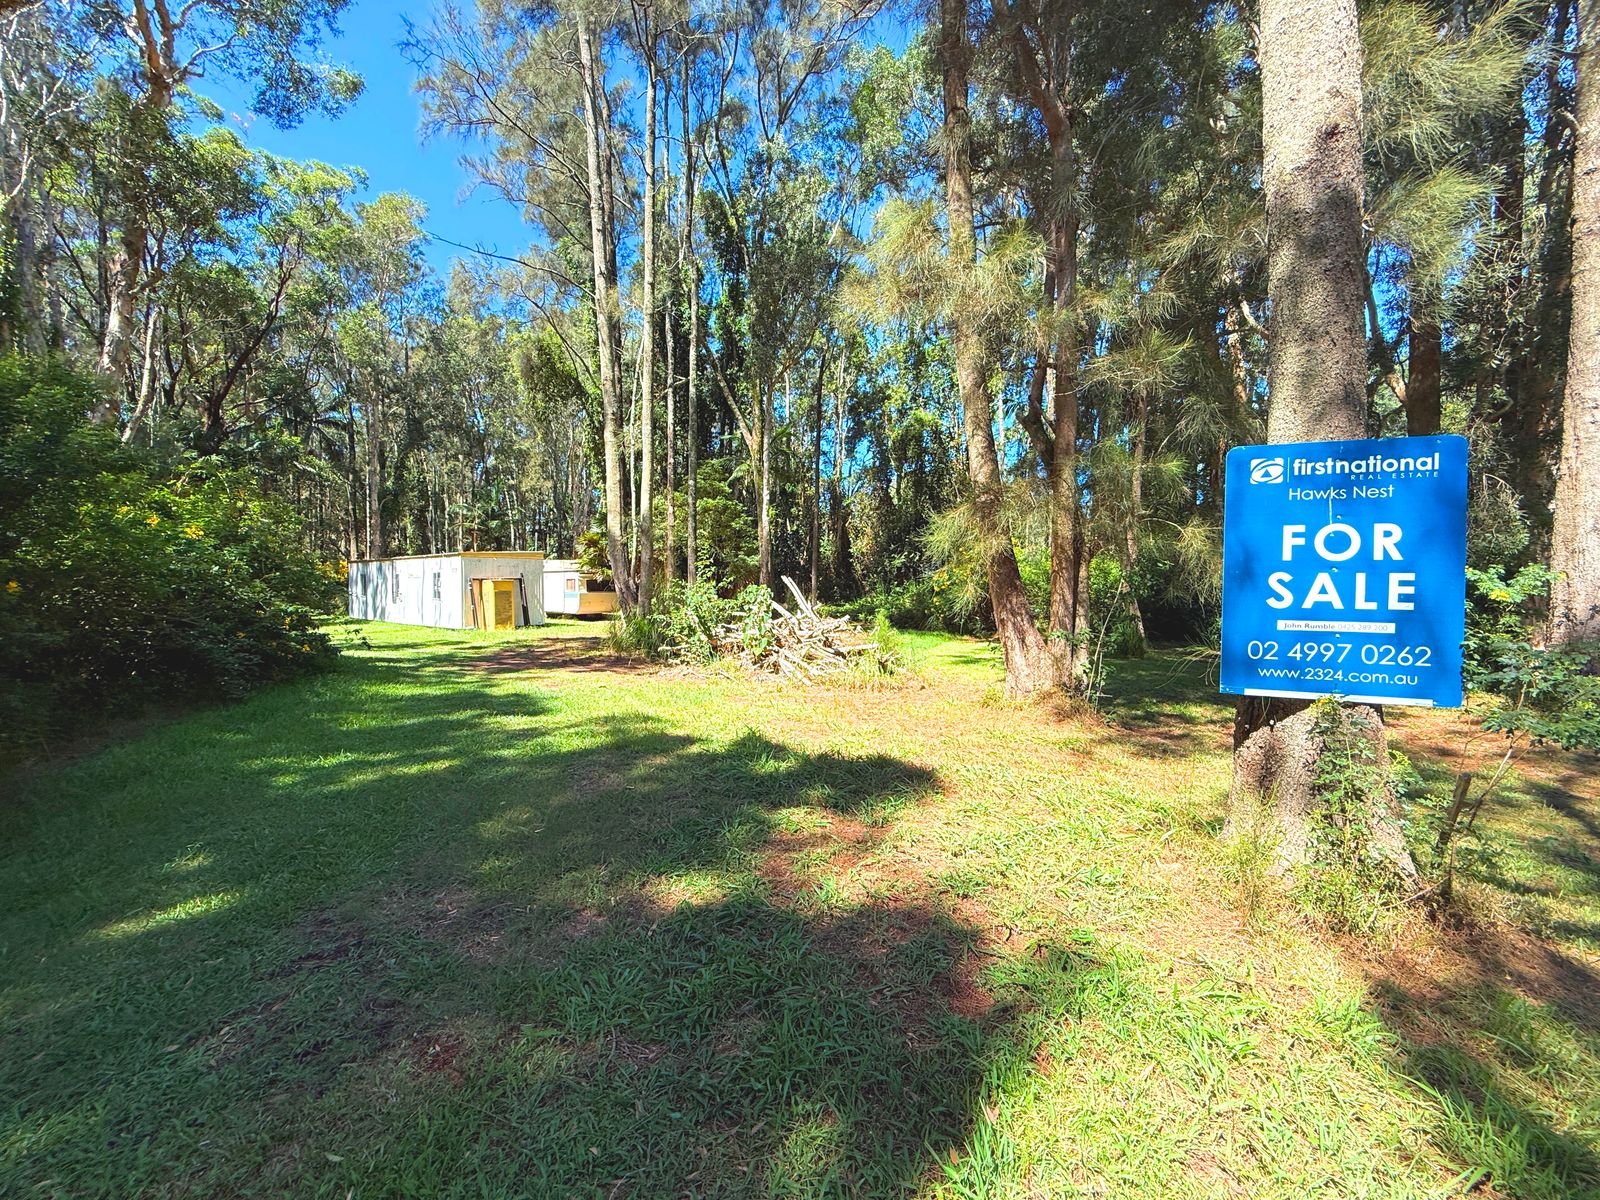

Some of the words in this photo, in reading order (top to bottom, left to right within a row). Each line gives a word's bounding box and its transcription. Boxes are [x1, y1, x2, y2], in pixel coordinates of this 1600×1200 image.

[1293, 453, 1439, 476] firstnational
[1392, 471, 1439, 479] ESTATE
[1289, 487, 1346, 501] Hawks
[1353, 484, 1394, 498] Nest
[1282, 523, 1403, 562] FOR
[1266, 571, 1416, 610] SALE
[1247, 640, 1279, 660] 02
[1287, 642, 1353, 663] 4997
[1361, 644, 1432, 667] 0262
[1258, 667, 1418, 685] www.2324.com.au
